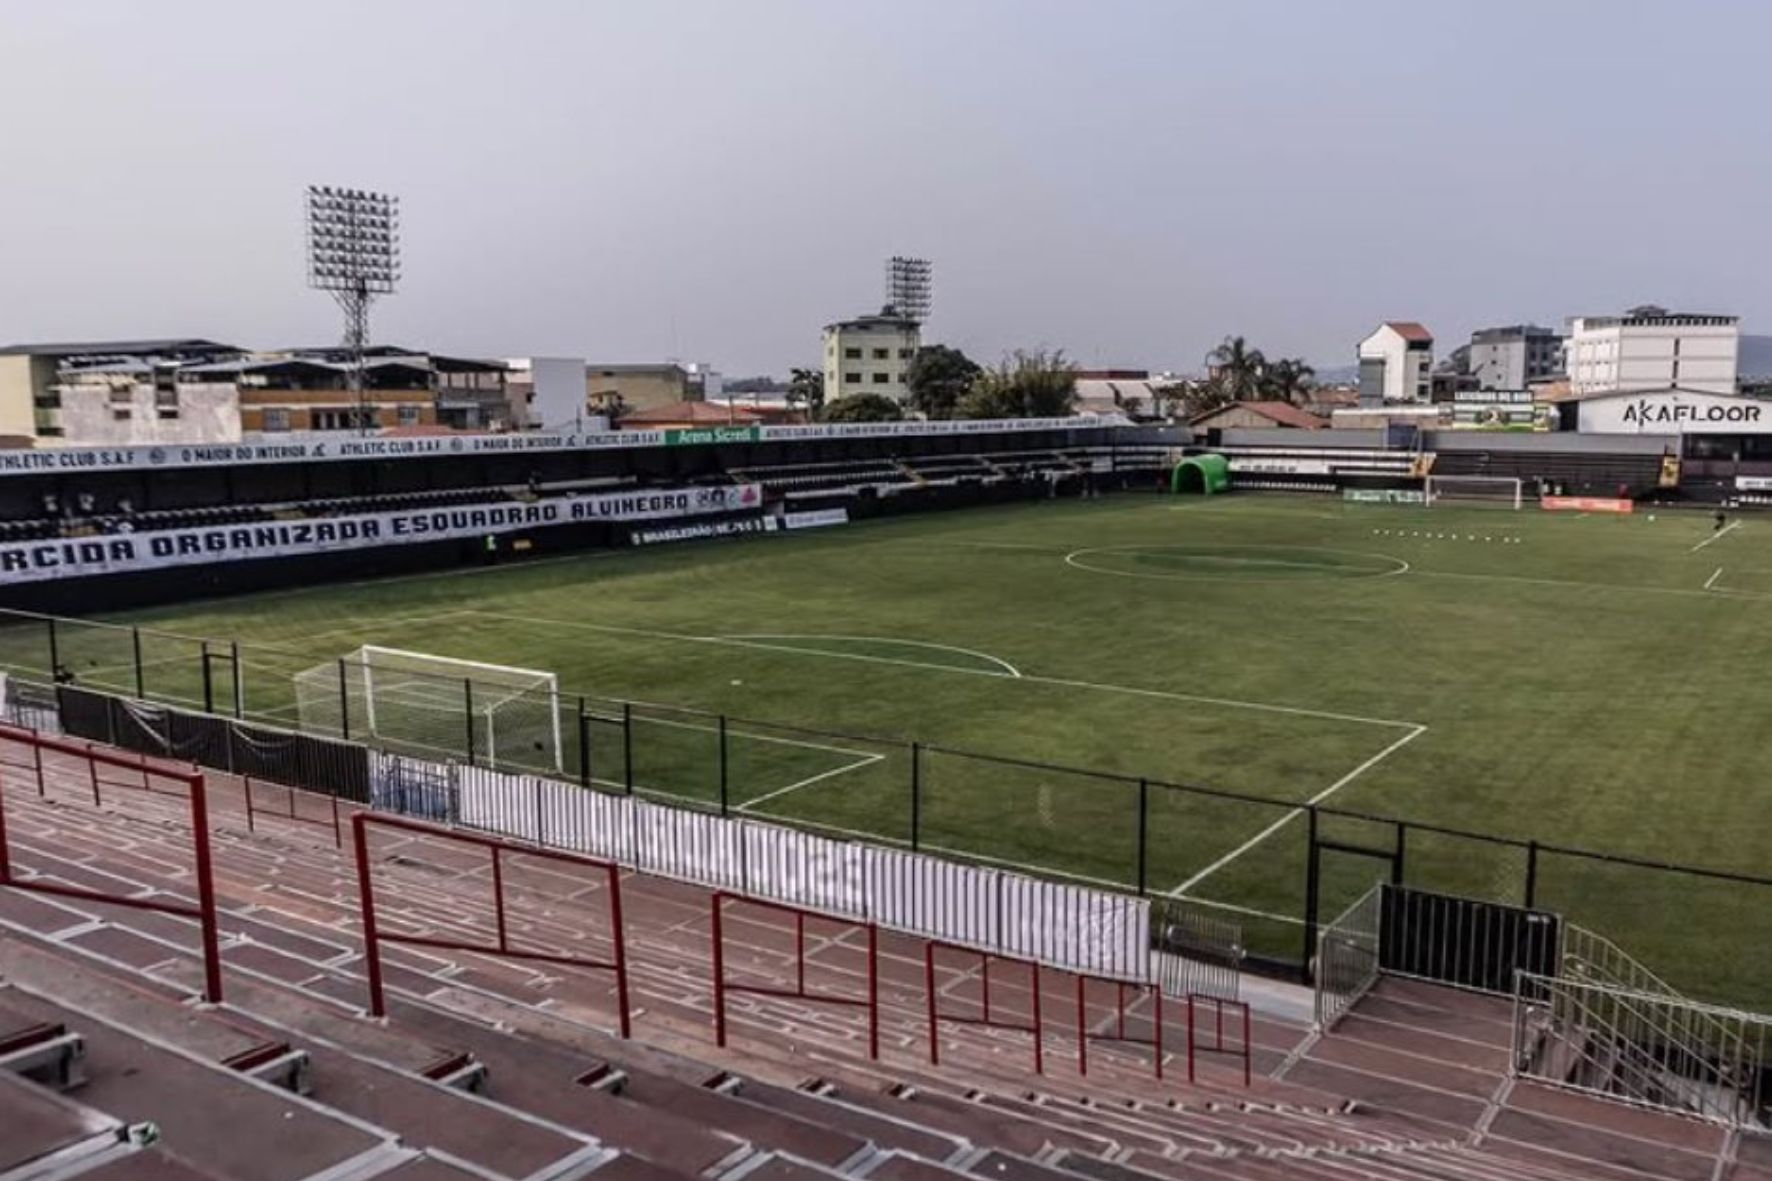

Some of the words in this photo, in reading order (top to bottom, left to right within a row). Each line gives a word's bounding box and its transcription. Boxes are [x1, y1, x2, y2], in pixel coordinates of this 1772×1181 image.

[1623, 400, 1761, 426] AKAFLOOR
[678, 430, 712, 443] Arena
[181, 449, 191, 462] O
[194, 447, 233, 460] MAIOR
[236, 447, 251, 459] DO
[255, 446, 306, 459] INTERIOR
[341, 442, 385, 455] ATHLETIC
[389, 440, 414, 453] CLUB
[60, 451, 96, 467] CLUB
[151, 520, 380, 557] ORGANIZADA
[571, 494, 688, 518] ALVINEGRO
